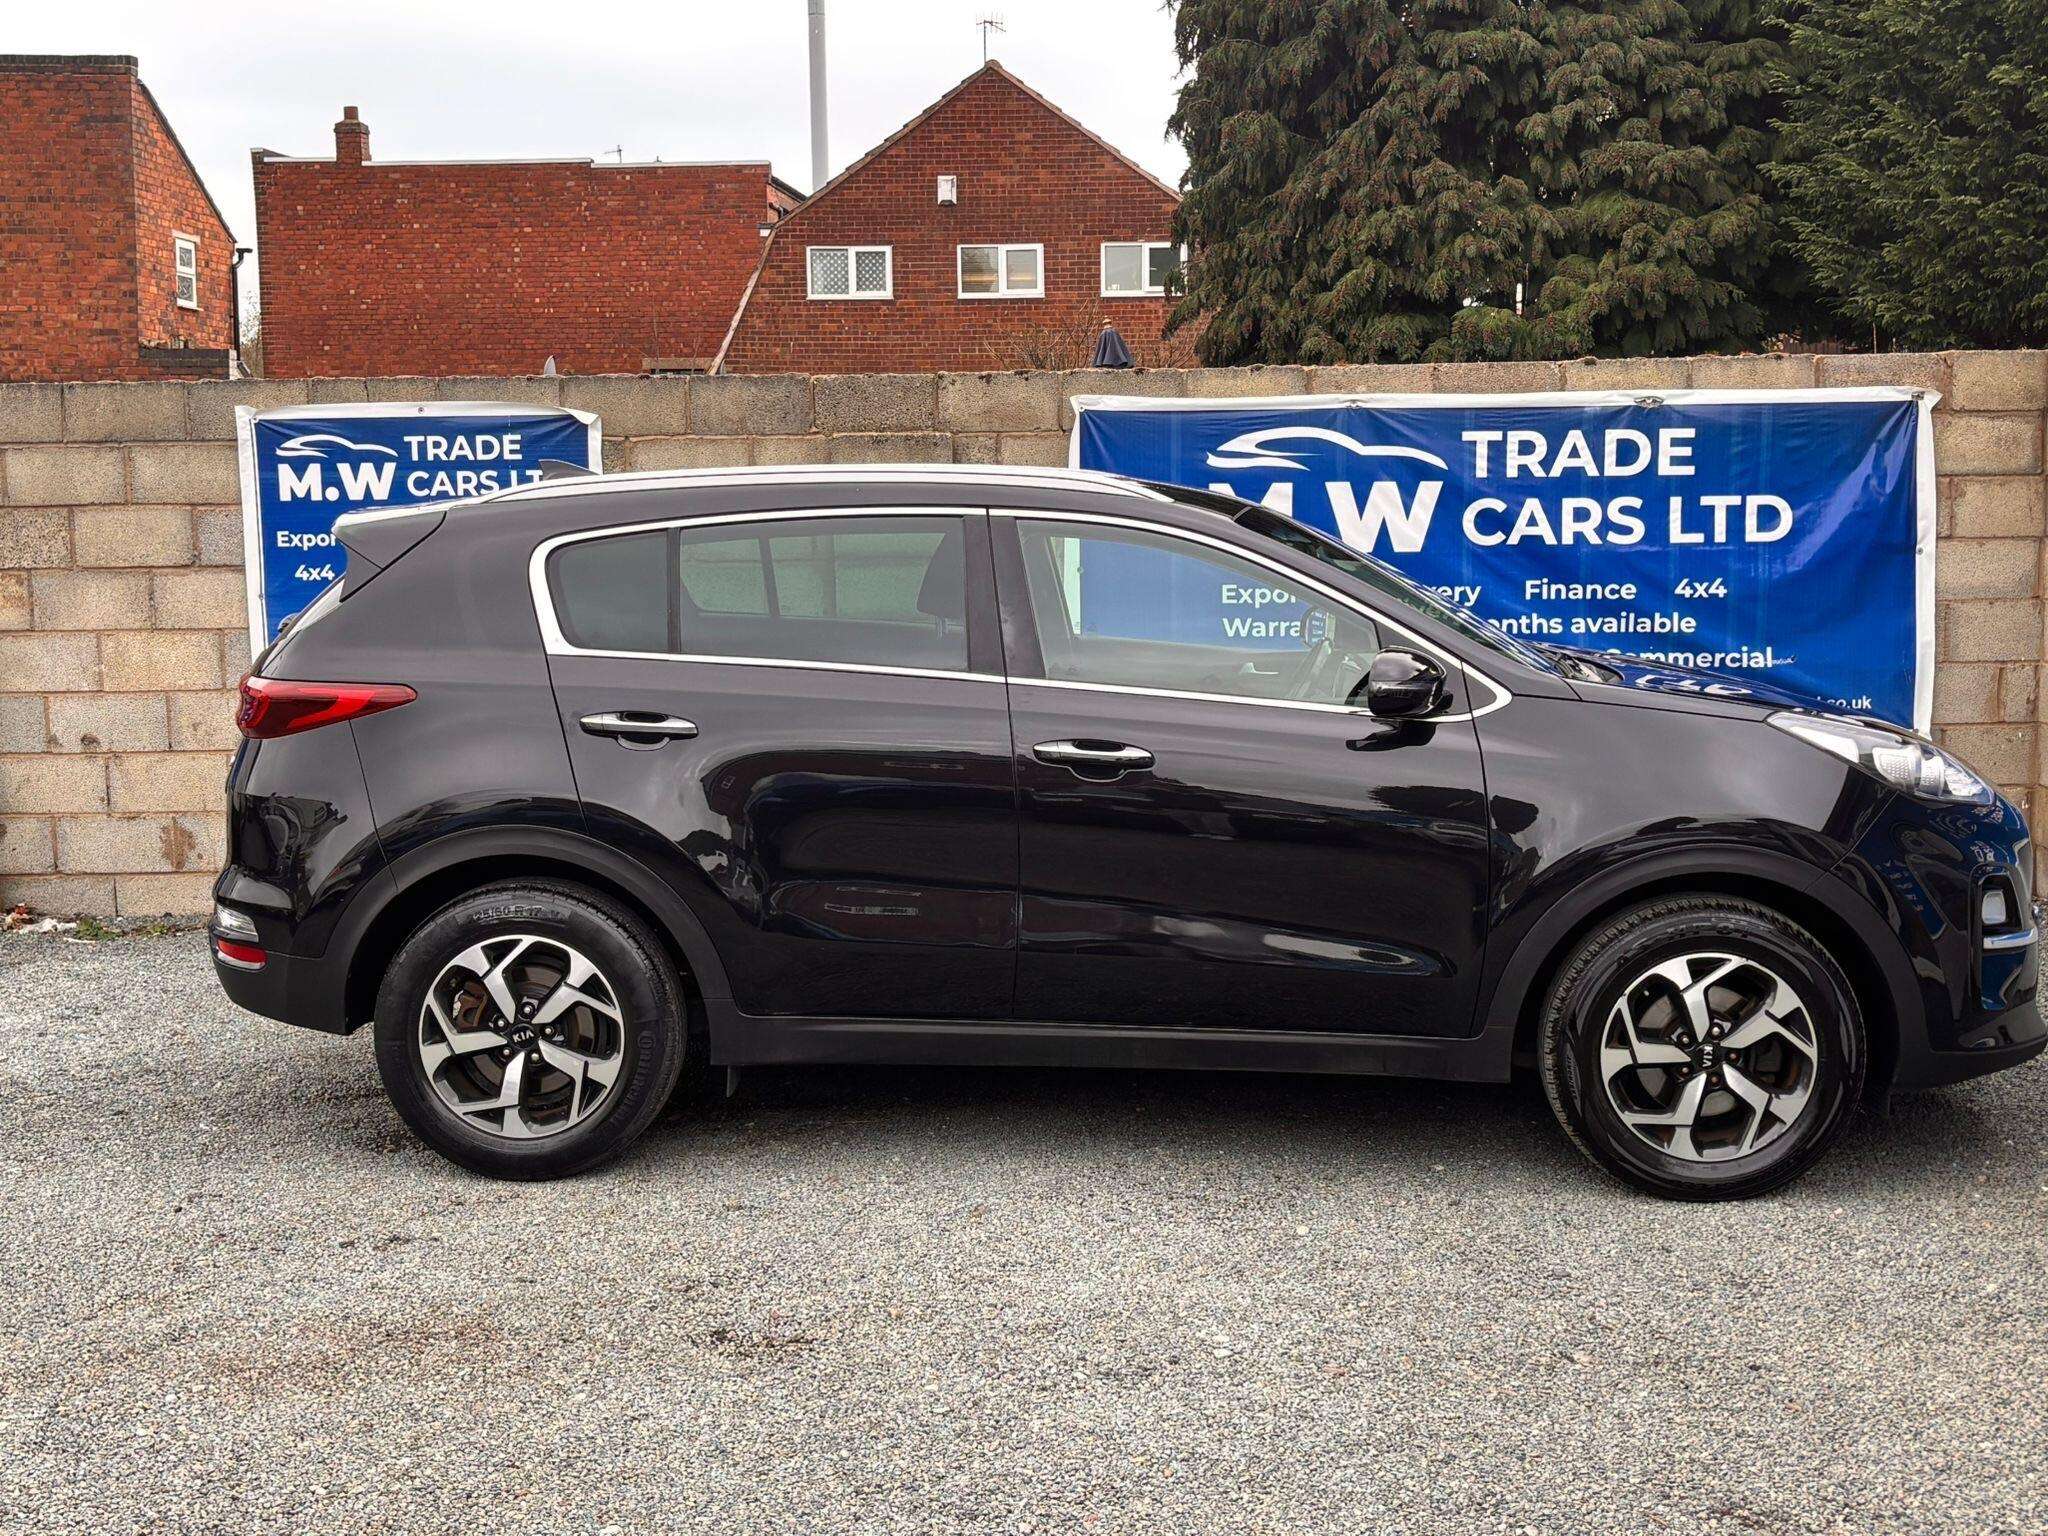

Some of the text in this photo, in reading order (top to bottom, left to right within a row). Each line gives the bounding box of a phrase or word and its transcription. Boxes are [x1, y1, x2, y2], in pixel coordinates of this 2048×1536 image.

[404, 434, 523, 462] TRADE
[1462, 428, 1696, 478] TRADE
[277, 461, 397, 503] M.W
[407, 469, 500, 497] CARS
[1462, 494, 1794, 547] CARS LTD
[294, 563, 336, 581] 4x4
[1524, 577, 1637, 601] Finance
[1674, 577, 1728, 599] 4x4
[1570, 612, 1697, 635] available
[1605, 645, 1774, 669] mmercial
[512, 1030, 535, 1043] KIA
[1702, 1045, 1714, 1068] KIA
